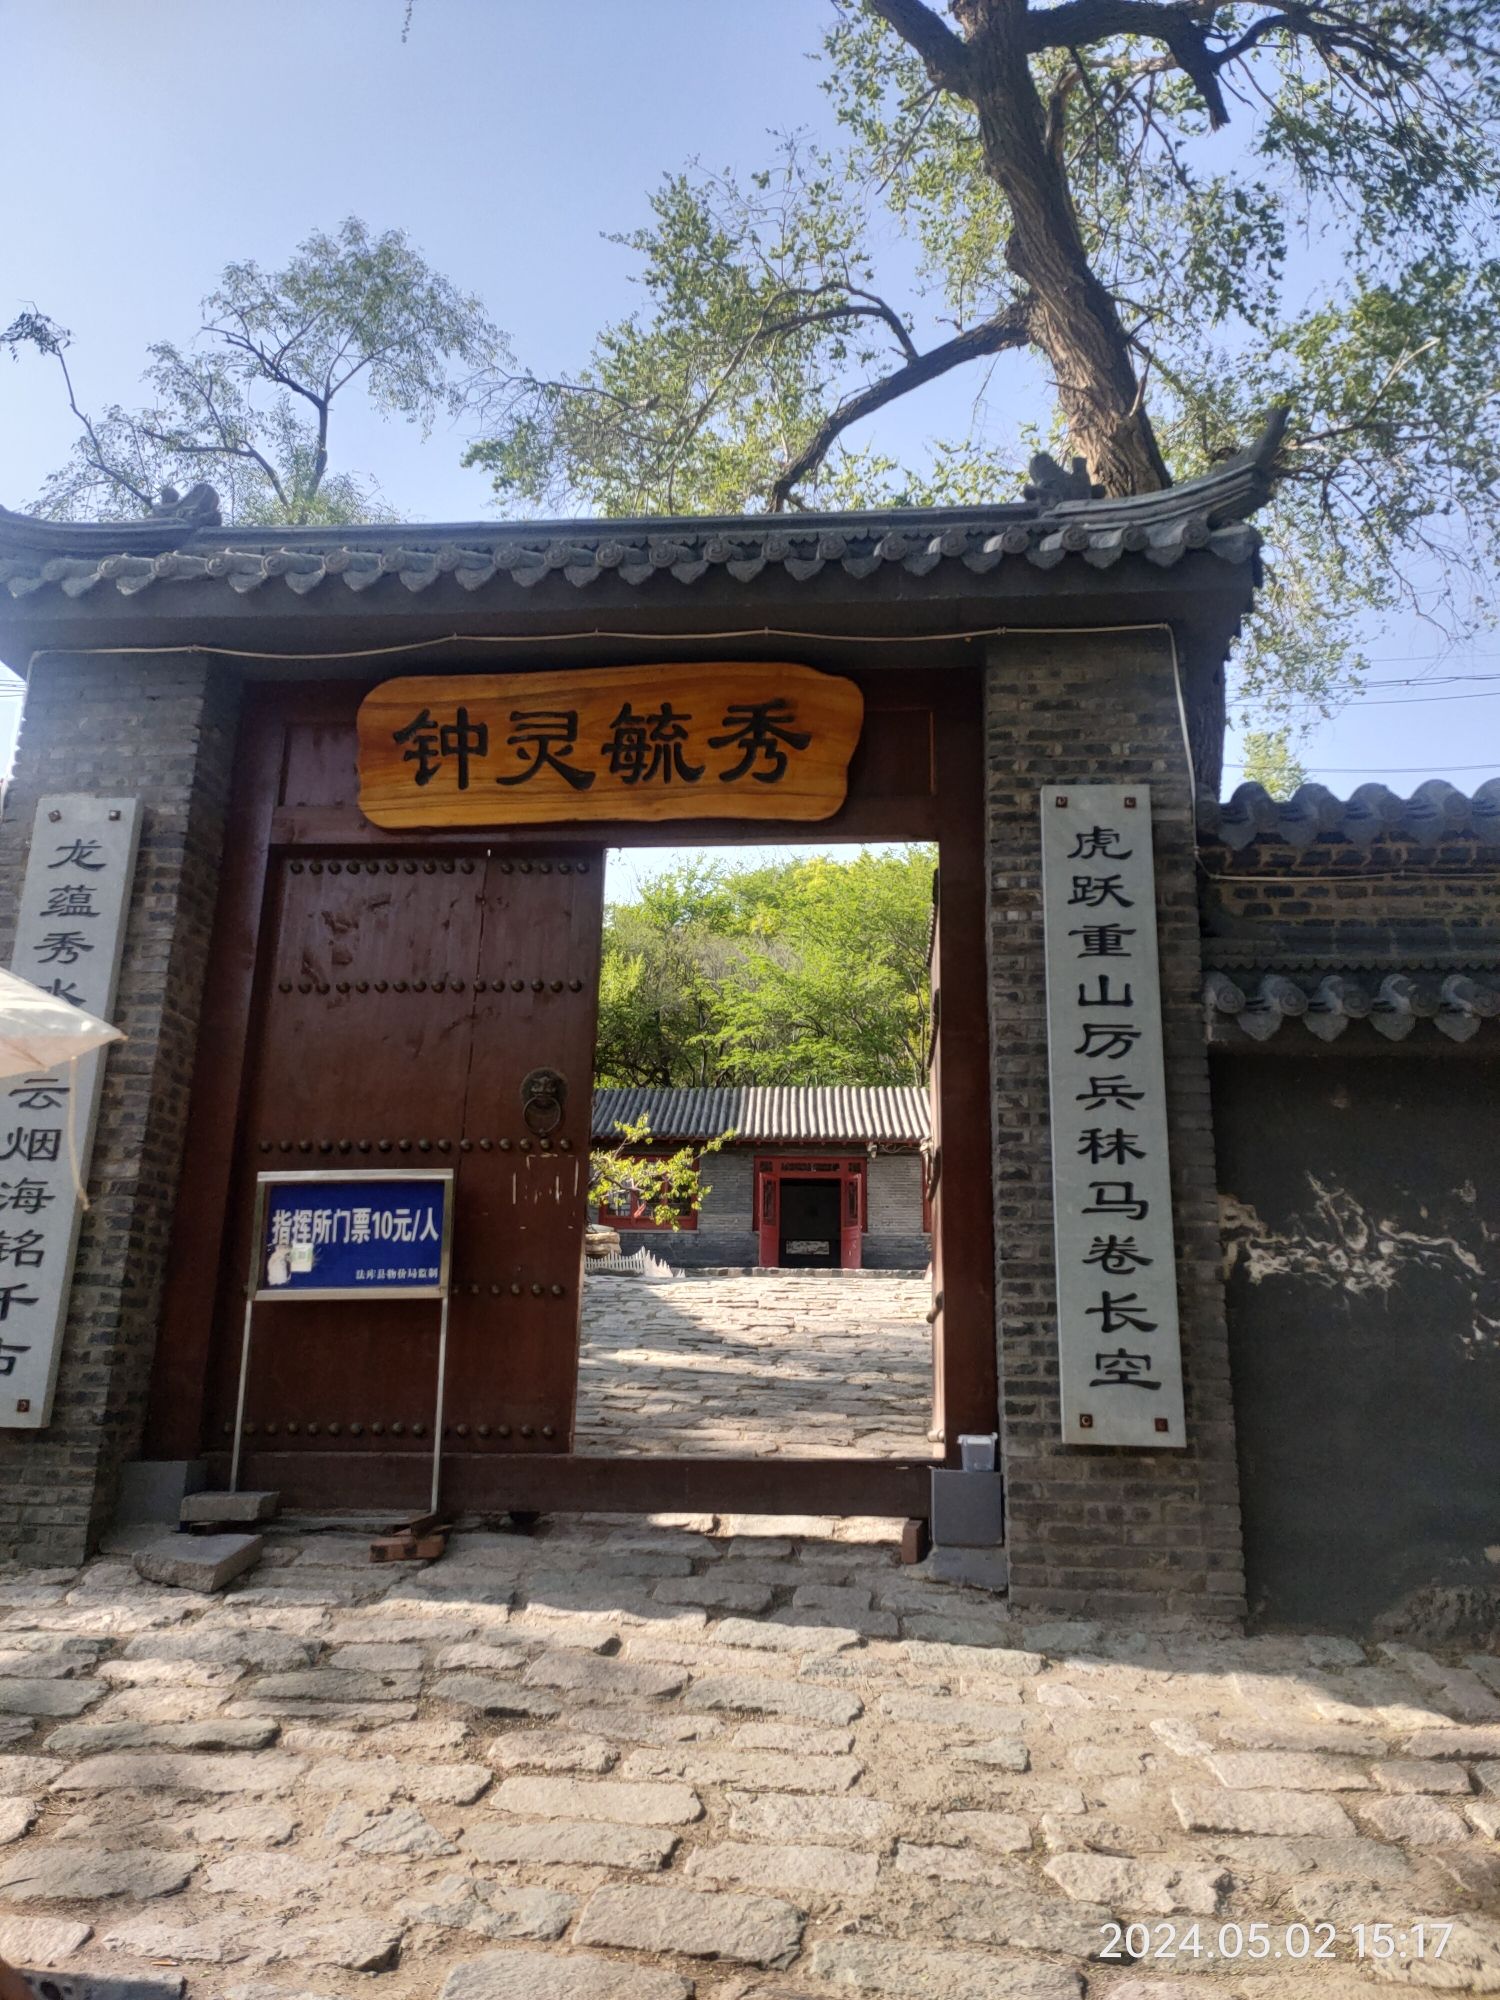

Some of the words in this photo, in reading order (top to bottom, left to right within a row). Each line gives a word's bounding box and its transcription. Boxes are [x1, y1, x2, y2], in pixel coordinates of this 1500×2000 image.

[393, 698, 812, 790] 钟灵毓秀
[1067, 825, 1162, 1391] 虎跃重山厉兵秣马卷长空
[271, 1207, 439, 1245] 指挥所门票10元/人
